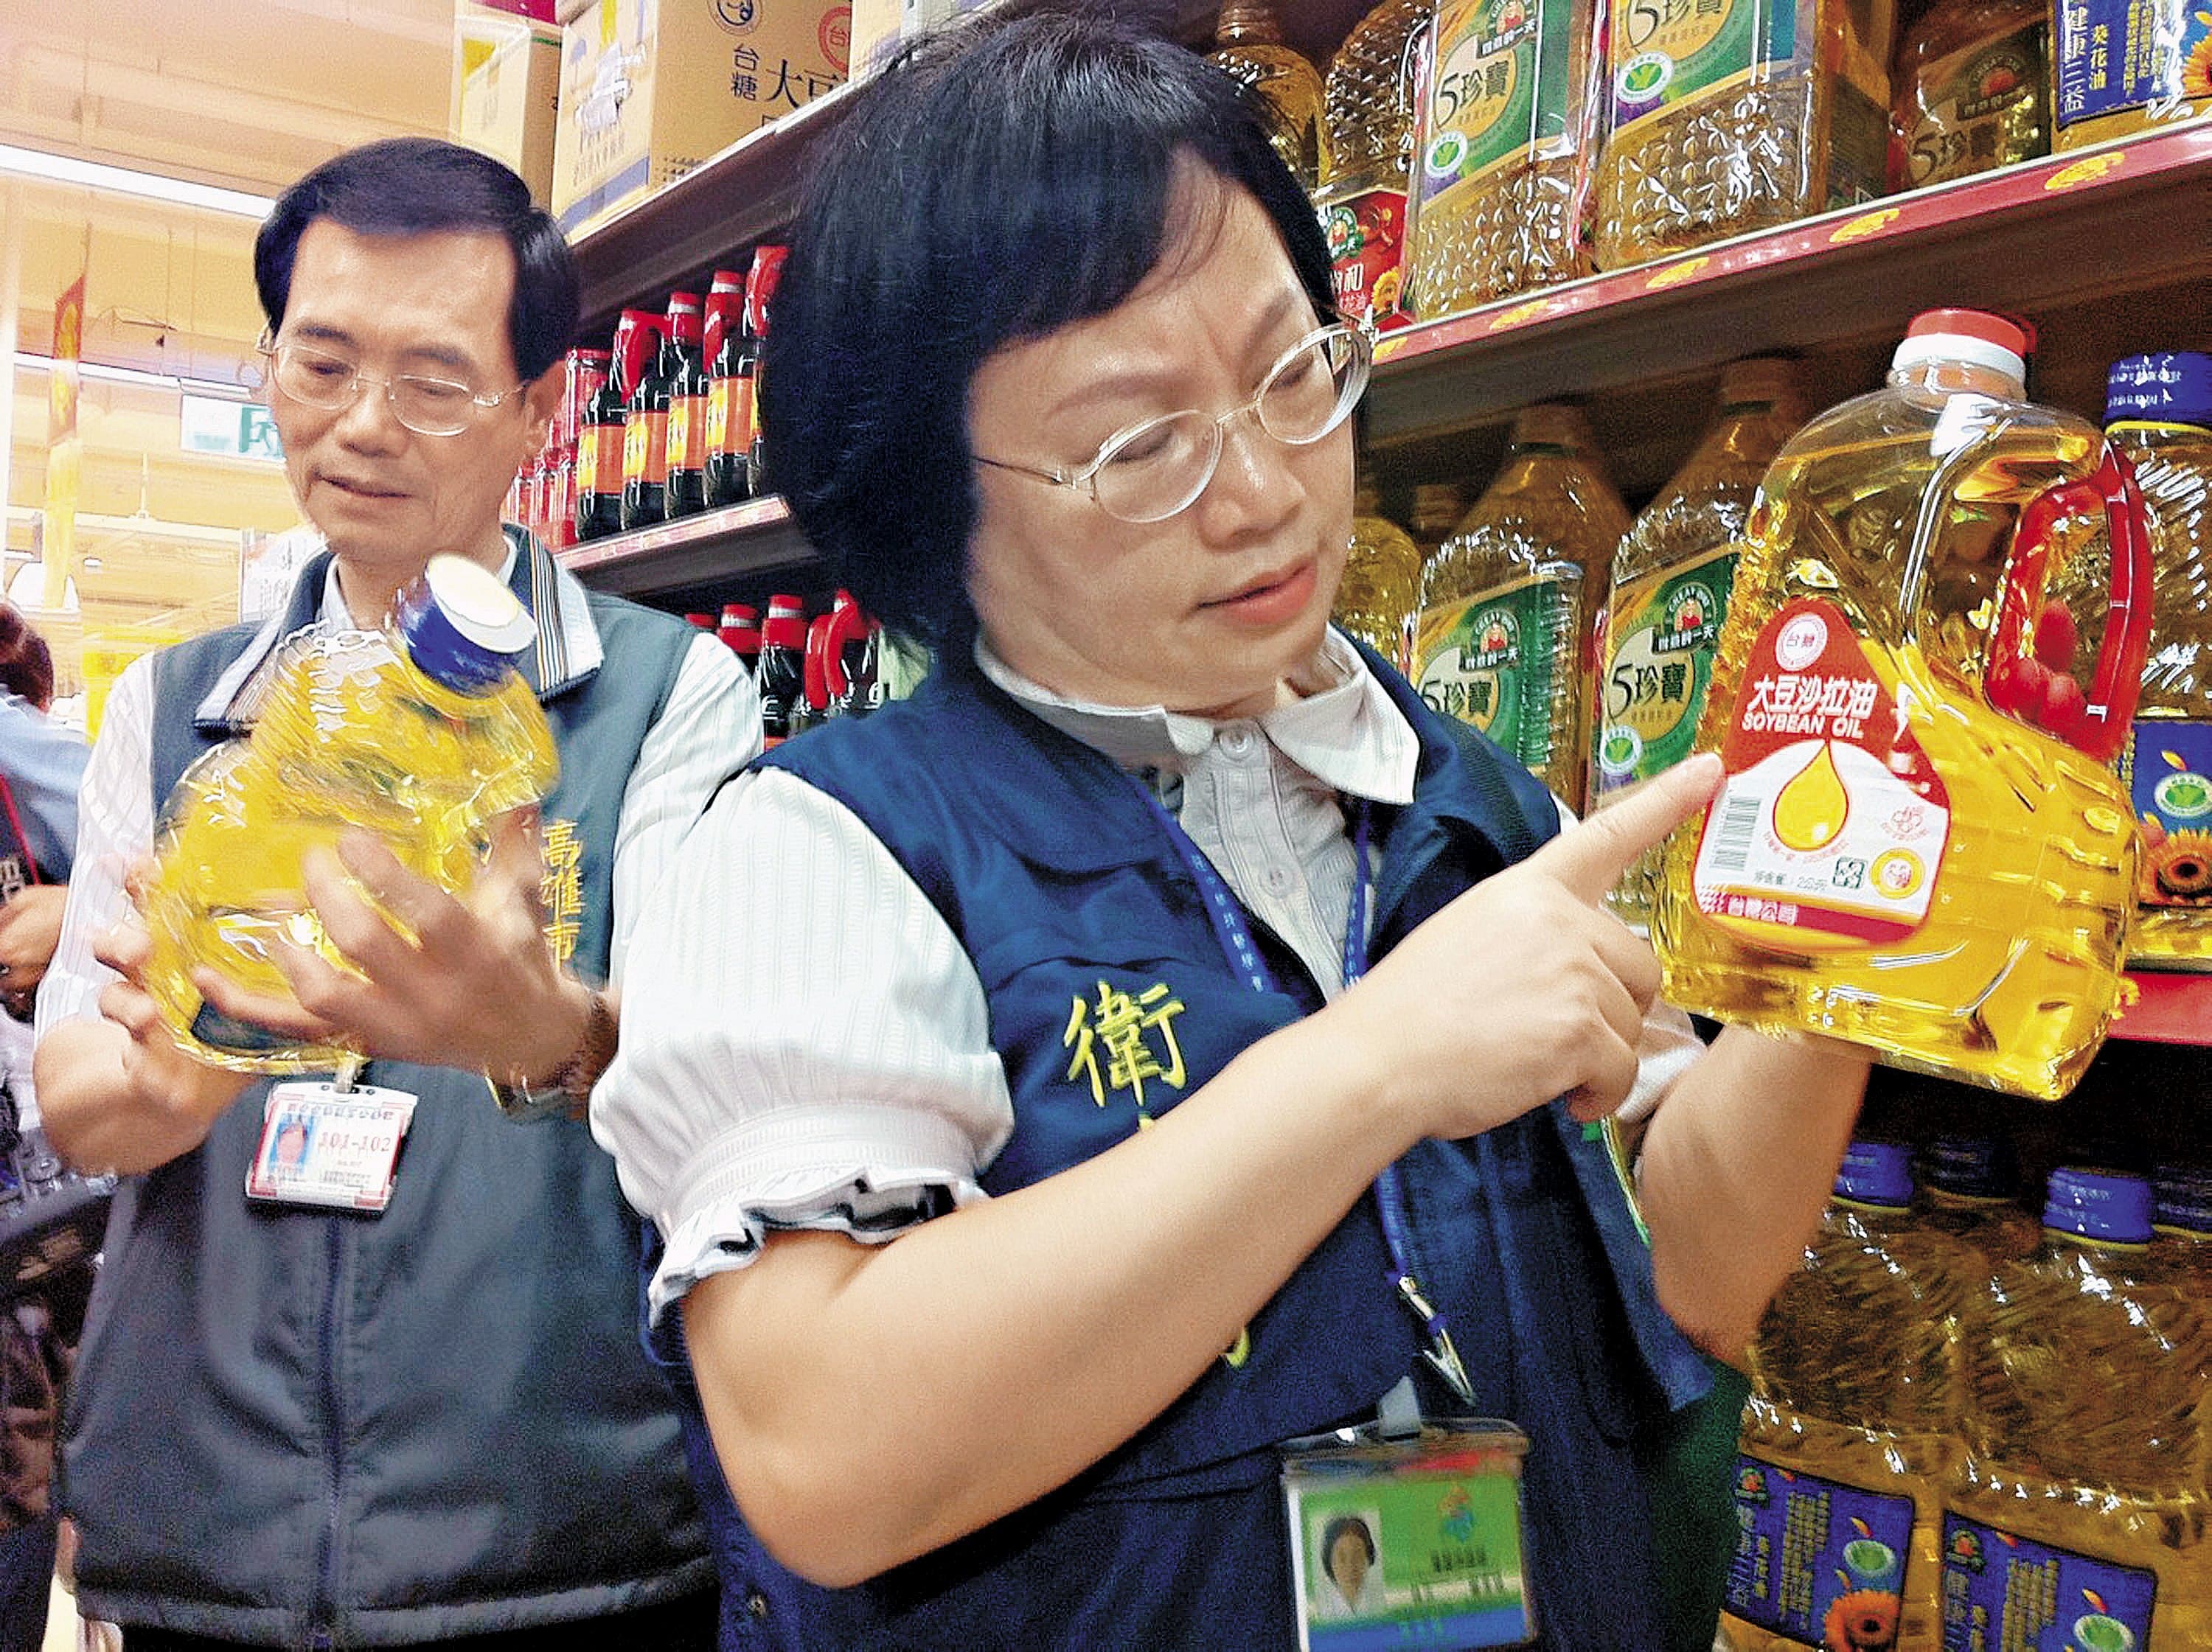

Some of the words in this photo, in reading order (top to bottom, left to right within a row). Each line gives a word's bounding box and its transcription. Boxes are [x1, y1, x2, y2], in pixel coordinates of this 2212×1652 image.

[731, 43, 759, 102] 台糖
[1742, 711, 1826, 735] SOYBEAN
[1832, 716, 1864, 739] OIL
[1746, 673, 1878, 719] 大豆沙拉油
[540, 819, 585, 968] 高雄市
[1064, 979, 1187, 1130] 衛
